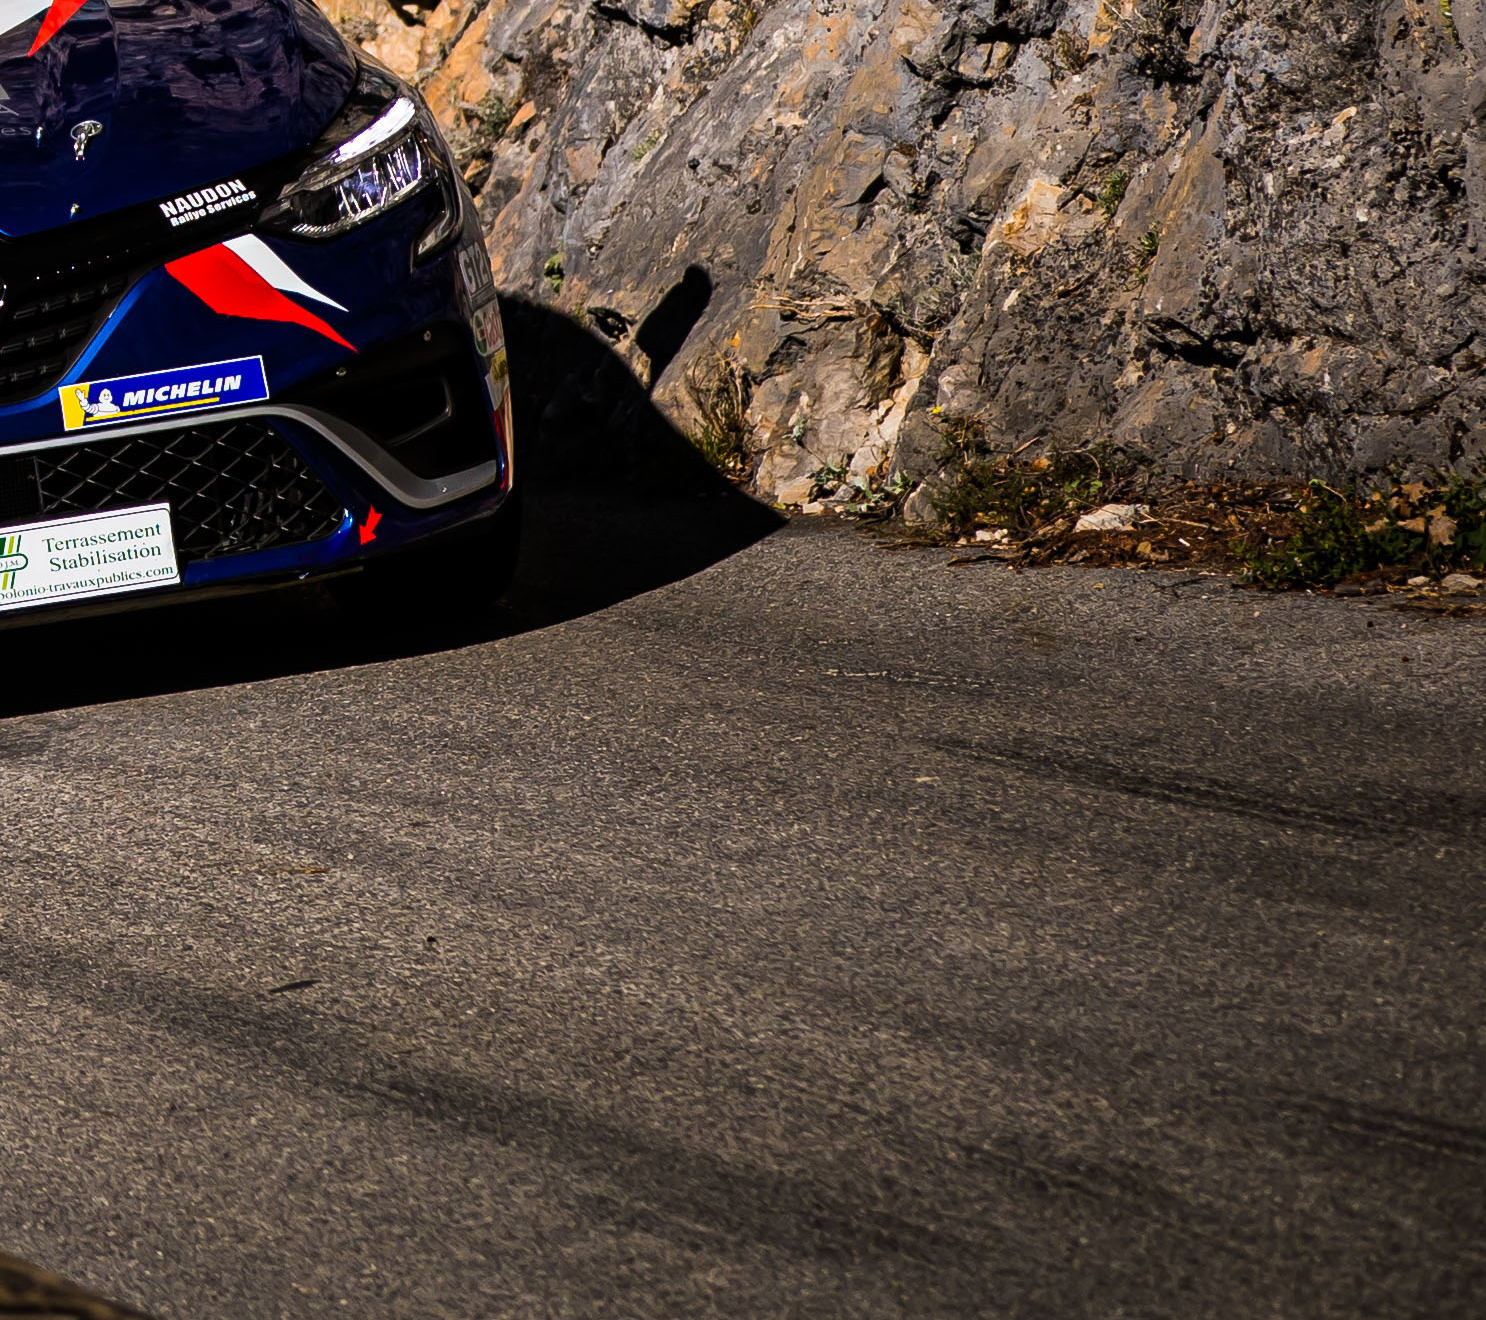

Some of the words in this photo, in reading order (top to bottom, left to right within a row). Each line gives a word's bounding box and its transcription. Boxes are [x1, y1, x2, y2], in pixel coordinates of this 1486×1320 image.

[159, 179, 247, 218] NAUDON
[170, 208, 207, 227] Rallye
[206, 191, 257, 214] Services
[123, 375, 242, 407] MICHELIN
[41, 523, 162, 554] Terrassement
[49, 543, 162, 573] Stabilisation
